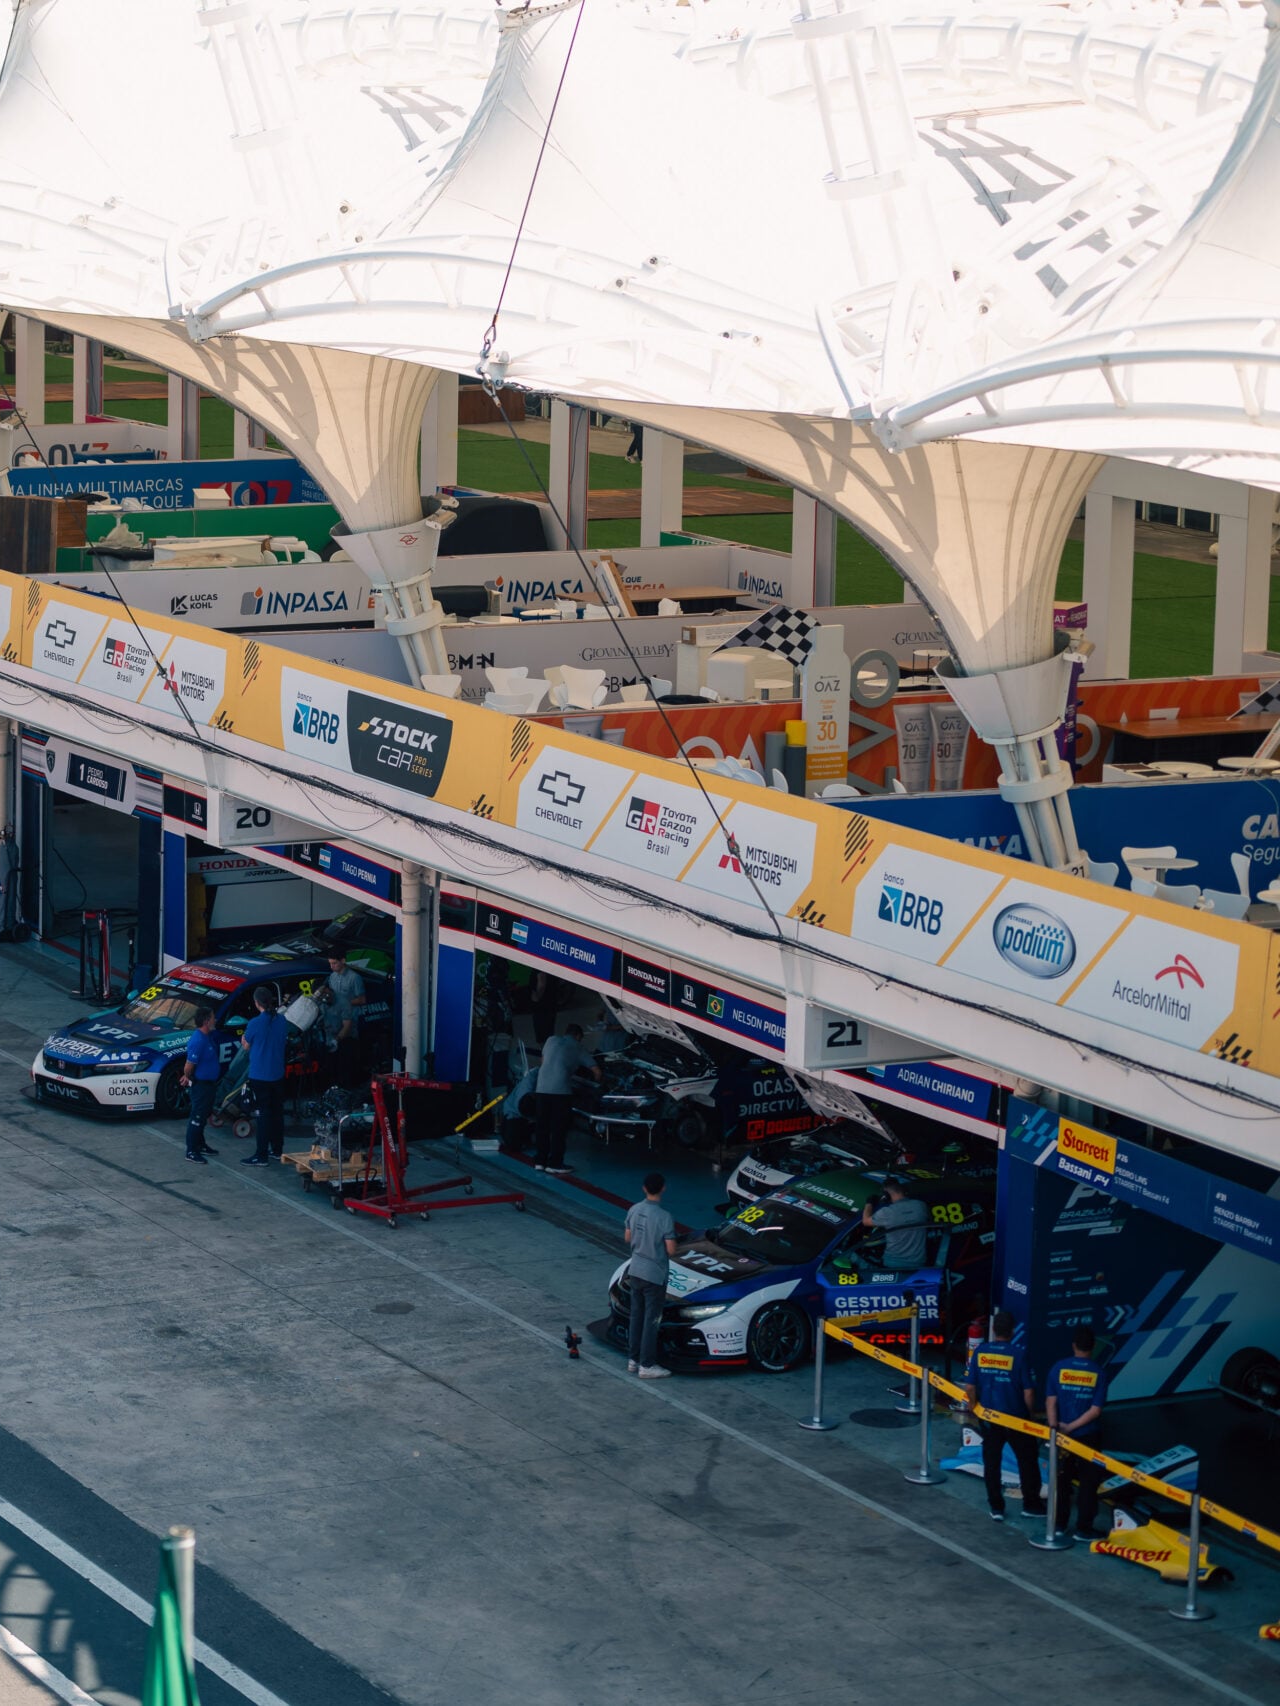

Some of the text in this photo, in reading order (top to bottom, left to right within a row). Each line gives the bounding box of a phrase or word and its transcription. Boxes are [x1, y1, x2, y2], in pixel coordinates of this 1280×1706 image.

[30, 483, 74, 496] LINHA
[78, 478, 184, 494] MULTIMARCAS
[748, 574, 783, 599] INPASA
[190, 593, 219, 602] LUCAS
[190, 601, 213, 609] KOHL
[265, 590, 349, 618] INPASA
[43, 649, 75, 667] CHEVROLET
[124, 652, 147, 666] GAZOO
[126, 643, 150, 658] TOYOTA
[123, 661, 145, 676] Racing
[181, 670, 215, 691] MITSUBISHI
[180, 683, 205, 701] MOTORS
[307, 706, 340, 745] BRB
[366, 715, 439, 753] STOCK
[816, 720, 838, 742] 30
[901, 743, 917, 760] 70
[936, 736, 952, 759] 50
[410, 763, 433, 779] SERIES
[414, 755, 427, 766] PRO
[86, 775, 109, 790] CARDOSO
[87, 765, 104, 779] PEDRO
[236, 806, 271, 829] 20
[535, 805, 584, 831] CHEVROLET
[659, 816, 693, 836] GAZOO
[661, 805, 698, 826] TOYOTA
[646, 839, 671, 857] Brasil
[656, 827, 690, 848] Racing
[198, 857, 259, 871] HONDA
[745, 845, 798, 874] MITSUBISHI
[341, 860, 377, 885] TIAGO PERNIA
[744, 863, 782, 887] MOTORS
[883, 872, 905, 886] banco
[899, 889, 944, 937] BRB
[541, 935, 597, 966] LEONEL PERNIA
[1001, 925, 1068, 967] podium
[1111, 979, 1192, 1023] ArcelorMittal
[732, 1008, 762, 1030] NELSON
[87, 1023, 138, 1041] YPF
[826, 1020, 863, 1048] 21
[45, 1082, 80, 1100] CIVIC
[108, 1086, 140, 1097] OCASA
[897, 1067, 975, 1104] ADRIAN CHIRIANO
[1062, 1126, 1110, 1163] Starrett
[742, 1165, 767, 1181] HONDA
[1058, 1156, 1093, 1181] Bassani
[810, 1184, 855, 1208] HONDA
[737, 1206, 766, 1223] 88
[931, 1202, 965, 1225] 88
[679, 1249, 735, 1273] YPF
[837, 1272, 859, 1285] 88
[706, 1331, 743, 1340] CIVIC
